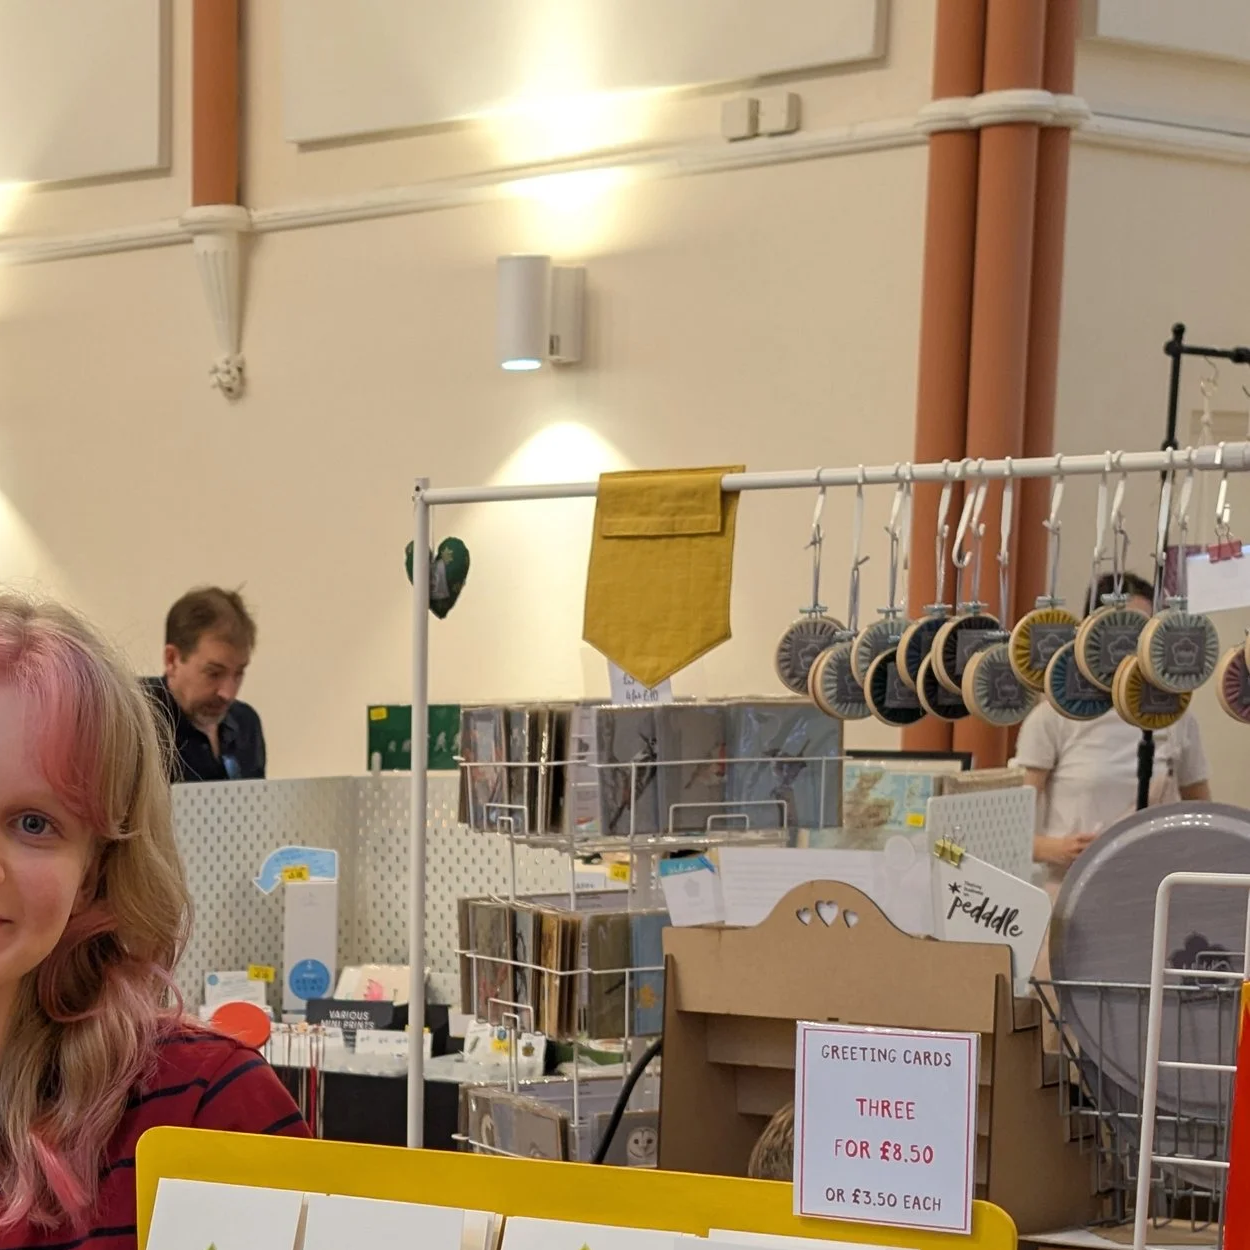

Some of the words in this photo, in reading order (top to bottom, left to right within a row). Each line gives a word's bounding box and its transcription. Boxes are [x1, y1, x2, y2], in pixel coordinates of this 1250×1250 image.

[329, 1010, 370, 1021] VARIOUS
[343, 1020, 375, 1030] PRINTS
[821, 1044, 897, 1064] GREETING
[903, 1049, 952, 1067] CARDS
[856, 1098, 916, 1120] THREE
[834, 1139, 870, 1159] FOR
[880, 1140, 934, 1164] £8.50
[825, 1187, 846, 1203] OR
[852, 1188, 897, 1208] £3.50
[903, 1194, 942, 1211] EACH
